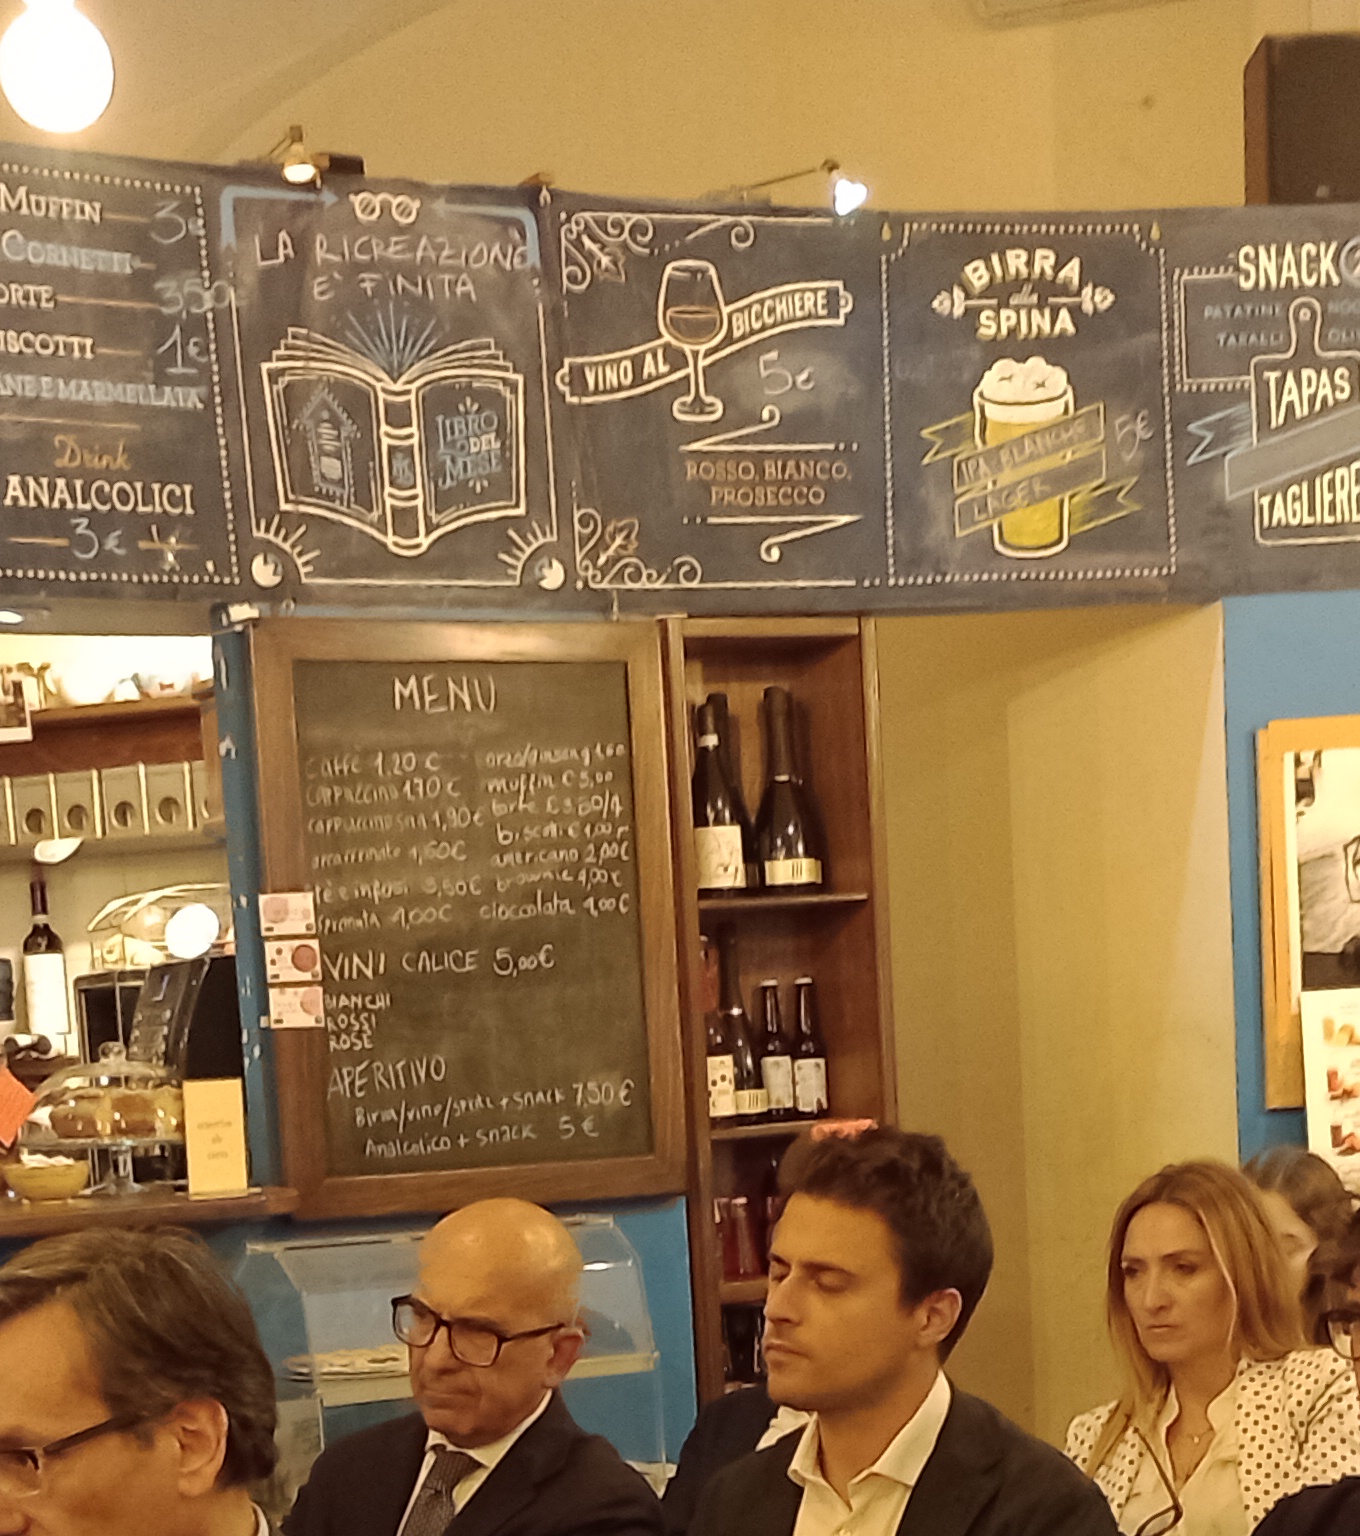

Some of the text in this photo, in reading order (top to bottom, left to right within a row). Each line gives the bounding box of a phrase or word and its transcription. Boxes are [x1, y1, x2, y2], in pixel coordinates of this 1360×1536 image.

[254, 229, 533, 271] LA RICREAZIONE
[1238, 241, 1340, 291] SNACK
[358, 272, 477, 301] FINITA
[961, 248, 1081, 294] BIRRA
[731, 289, 828, 340] BICCHIERE
[976, 307, 1076, 341] SPINA
[584, 351, 670, 392] VINO AL
[1262, 366, 1352, 430] TAPAS
[53, 433, 132, 471] Drink
[435, 410, 499, 454] LIBRO
[468, 431, 501, 453] DEL
[439, 454, 503, 491] MESE
[3, 473, 195, 516] ANALCOLICI
[710, 486, 826, 507] PROSECCO
[394, 673, 497, 714] MENU
[323, 950, 386, 982] VINI
[402, 949, 479, 974] CALICE
[326, 1013, 377, 1034] ROSSI
[327, 1054, 446, 1099] APERITIVO
